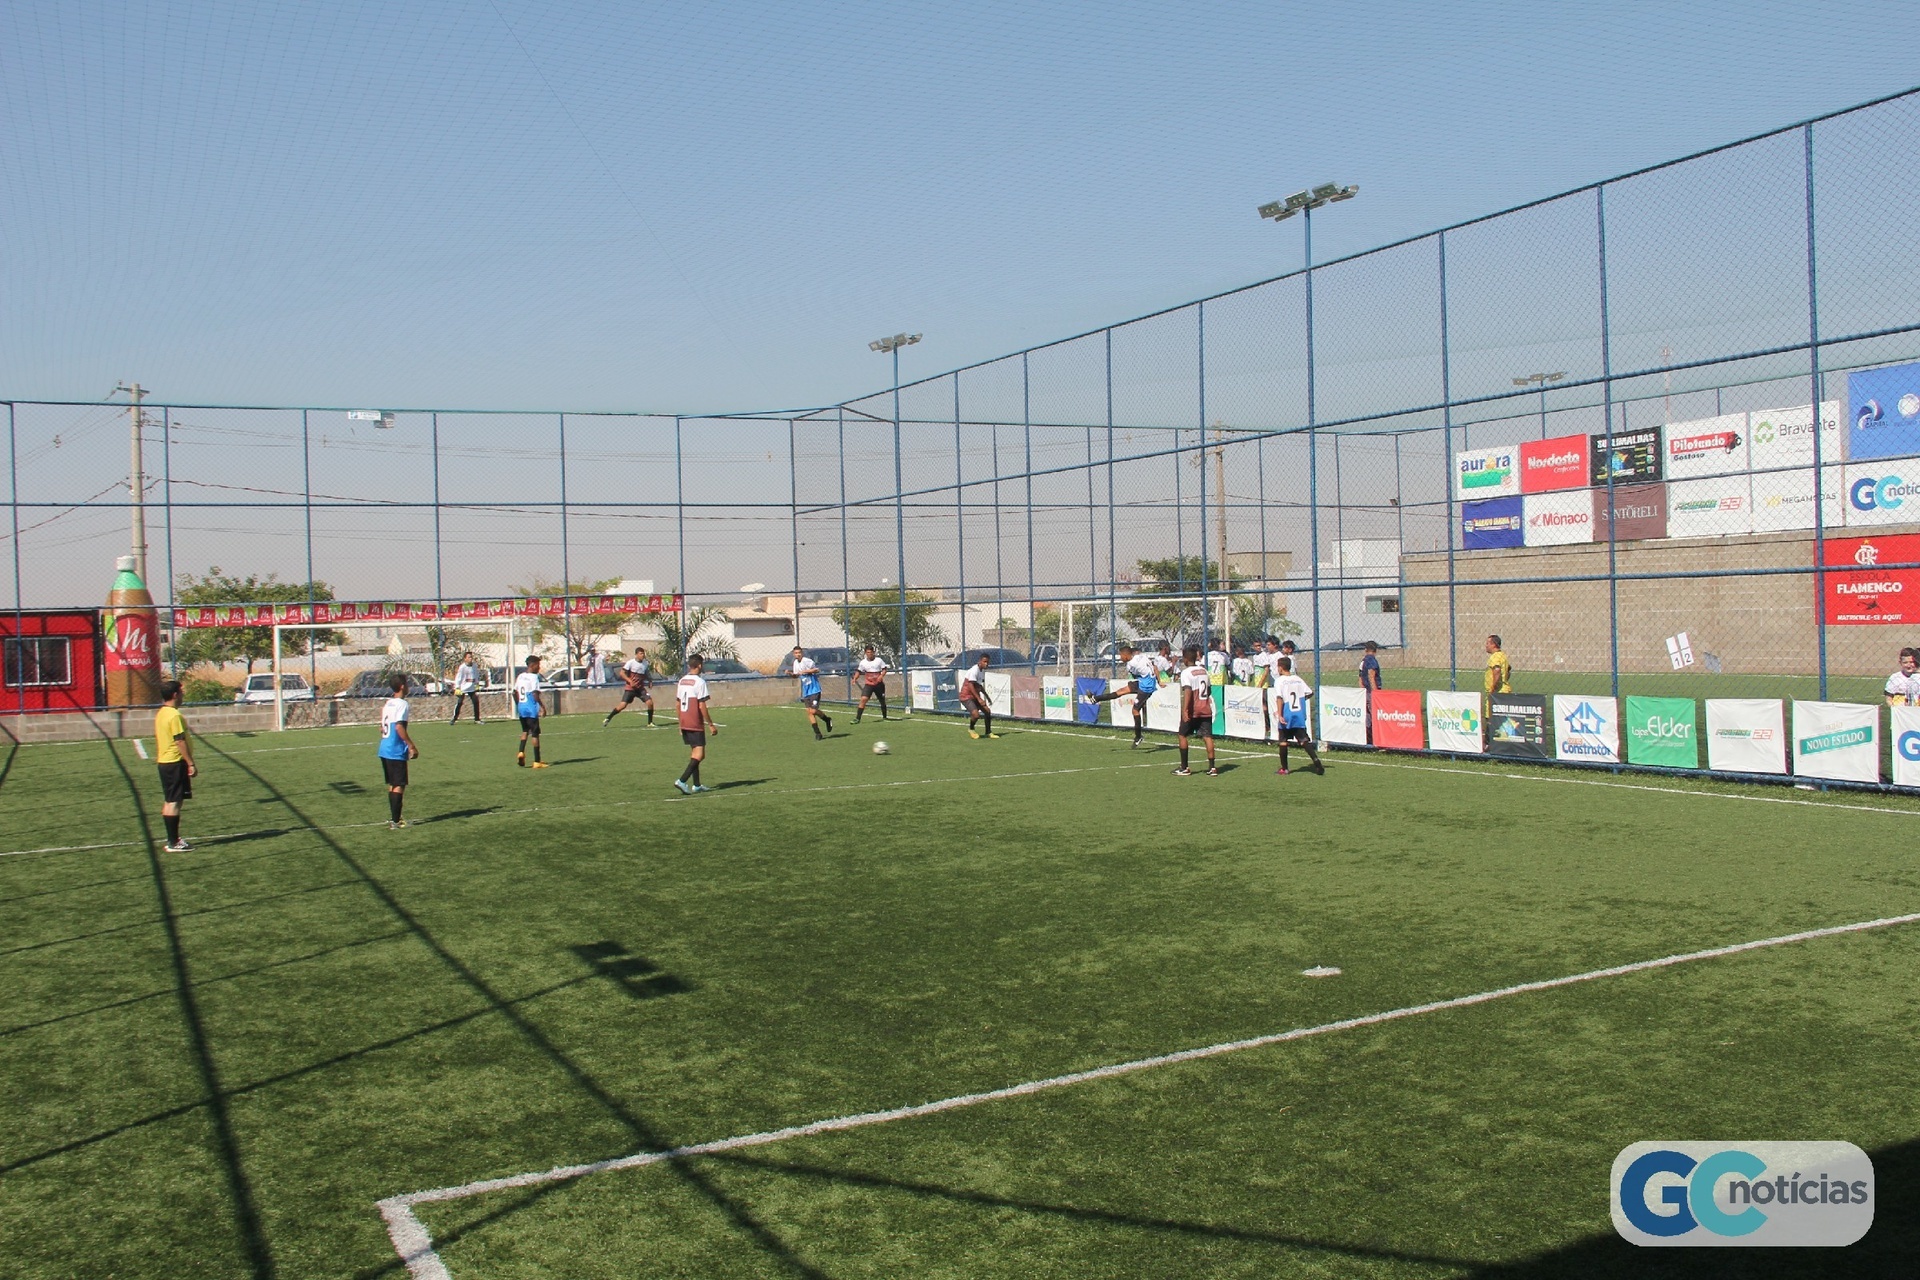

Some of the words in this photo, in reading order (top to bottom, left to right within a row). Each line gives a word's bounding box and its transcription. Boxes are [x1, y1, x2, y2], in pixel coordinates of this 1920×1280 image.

[1779, 419, 1836, 437] Bravate
[1597, 433, 1656, 449] SULIMALHAS
[1673, 436, 1726, 452] Pilotando
[1542, 512, 1588, 526] Mônaco
[1850, 572, 1891, 582] ESCOLA
[1836, 582, 1903, 594] FLAMENGO
[1684, 653, 1692, 663] 2
[1200, 680, 1207, 698] 2
[1290, 692, 1298, 709] 2
[1333, 707, 1361, 717] SICOOB
[1647, 716, 1692, 738] Elder
[1806, 738, 1830, 751] NOVO
[1831, 731, 1865, 746] ESTADO
